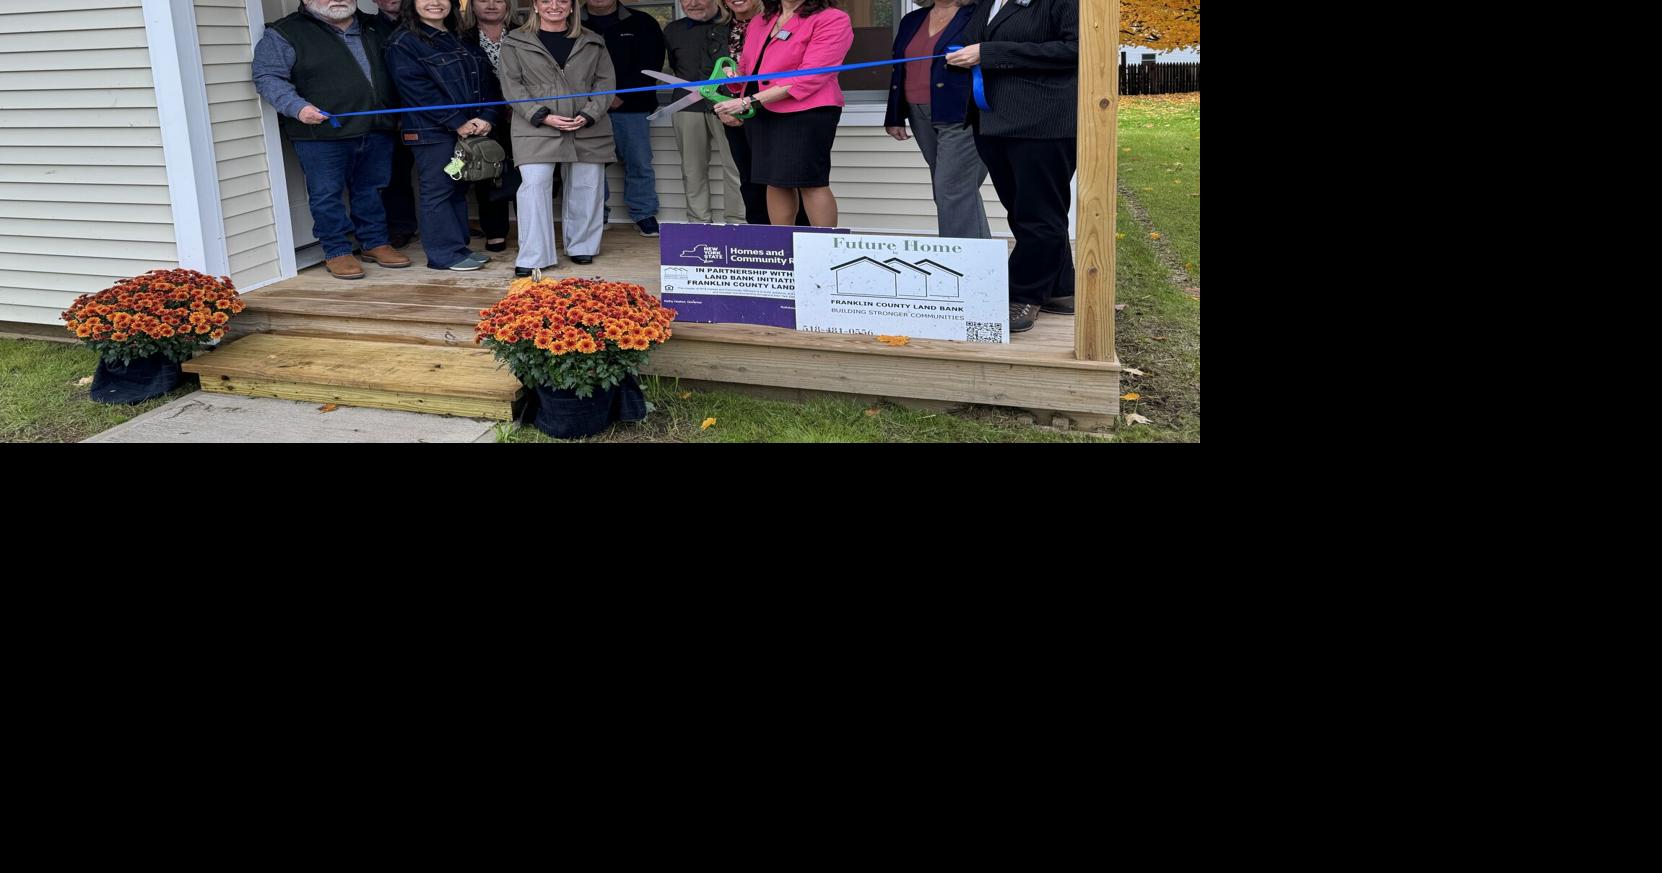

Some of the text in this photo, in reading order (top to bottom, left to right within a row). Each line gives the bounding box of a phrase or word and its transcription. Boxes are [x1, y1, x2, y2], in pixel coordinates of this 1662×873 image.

[833, 237, 962, 254] Future Home
[730, 255, 786, 265] Community
[910, 313, 965, 321] COMMUNITIES
